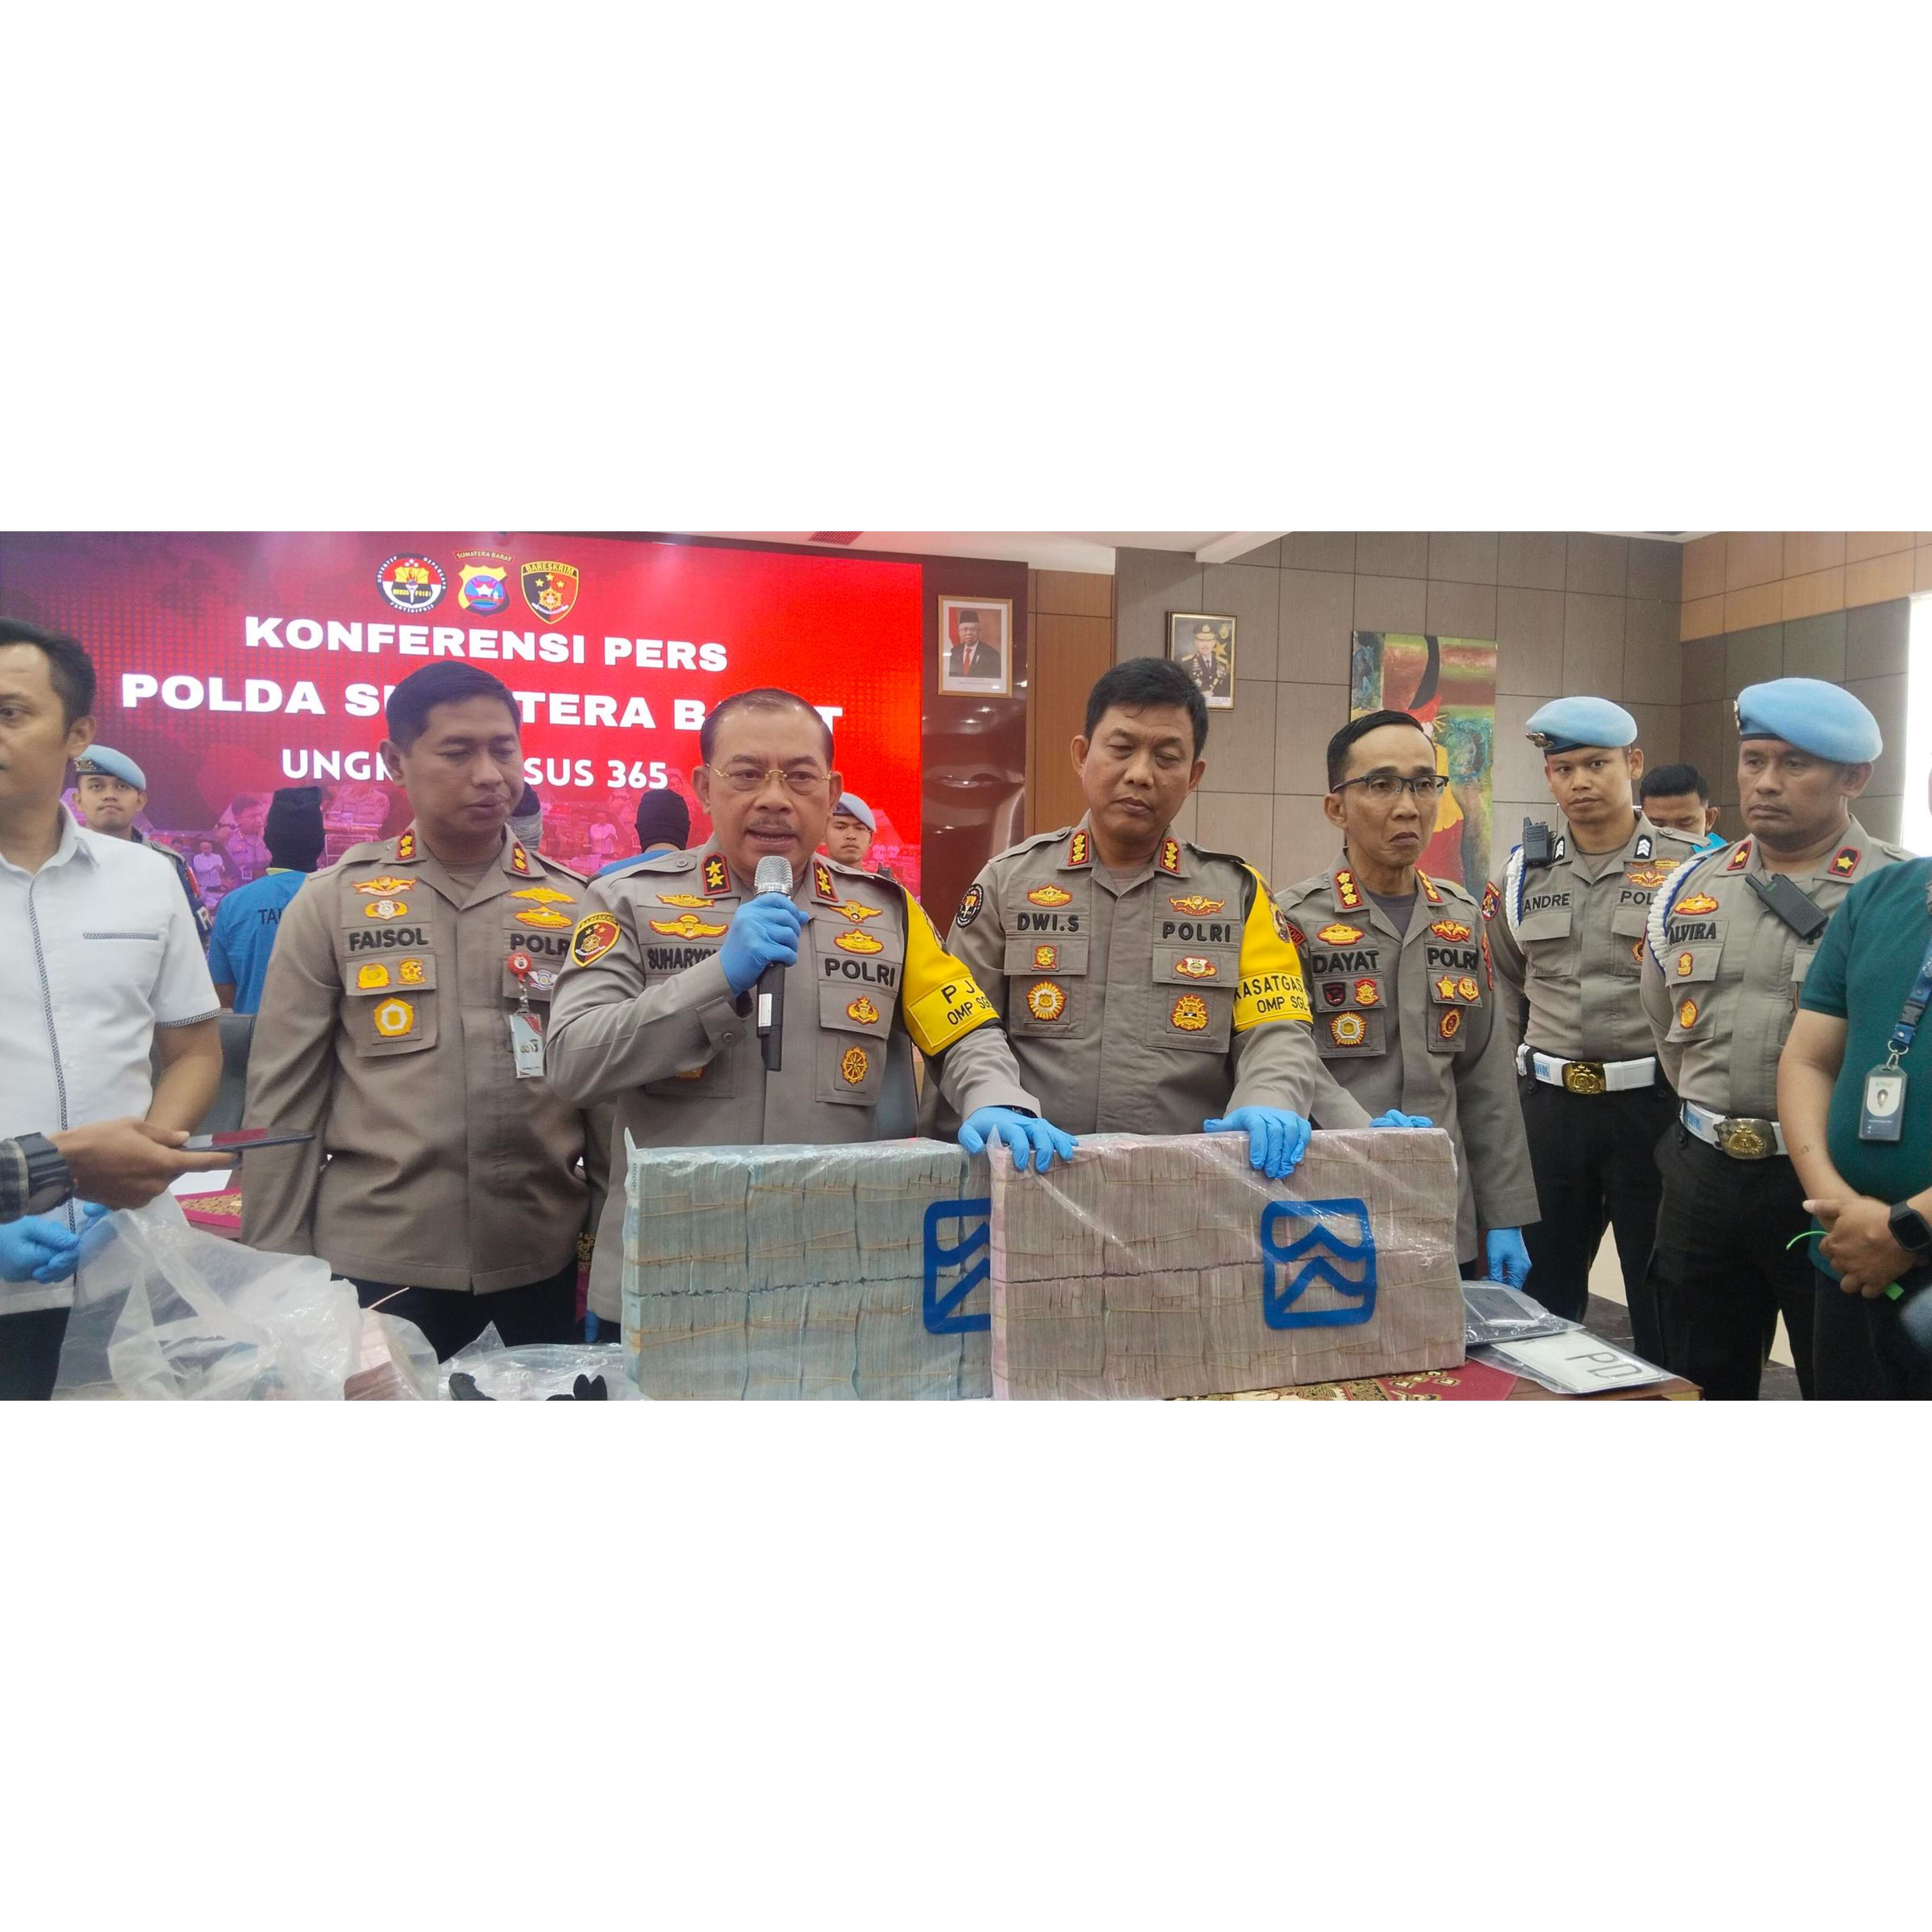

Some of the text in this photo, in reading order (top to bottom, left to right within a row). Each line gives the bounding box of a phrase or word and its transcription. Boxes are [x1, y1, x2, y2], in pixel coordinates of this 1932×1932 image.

[457, 551, 513, 562] SUMATERA BARAT
[525, 562, 575, 576] BARESKRIM
[245, 616, 728, 672] KONFERENSI PERS
[122, 674, 326, 715] POLDA
[345, 683, 656, 729] STERA
[524, 758, 594, 788] SUS
[607, 760, 668, 789] 365
[1524, 893, 1570, 913] ANDRE
[1620, 890, 1654, 905] POL
[1017, 912, 1079, 932] DWI.S
[1163, 921, 1230, 943] POLRI
[349, 927, 428, 951] FAISOL
[510, 933, 571, 956] POLR
[648, 947, 716, 970] SUHARYO
[1313, 950, 1380, 974] DAYAT
[1428, 947, 1479, 970] POLRI
[825, 958, 895, 987] POLRI
[947, 1001, 973, 1025] OMP
[1257, 996, 1285, 1013] OMP
